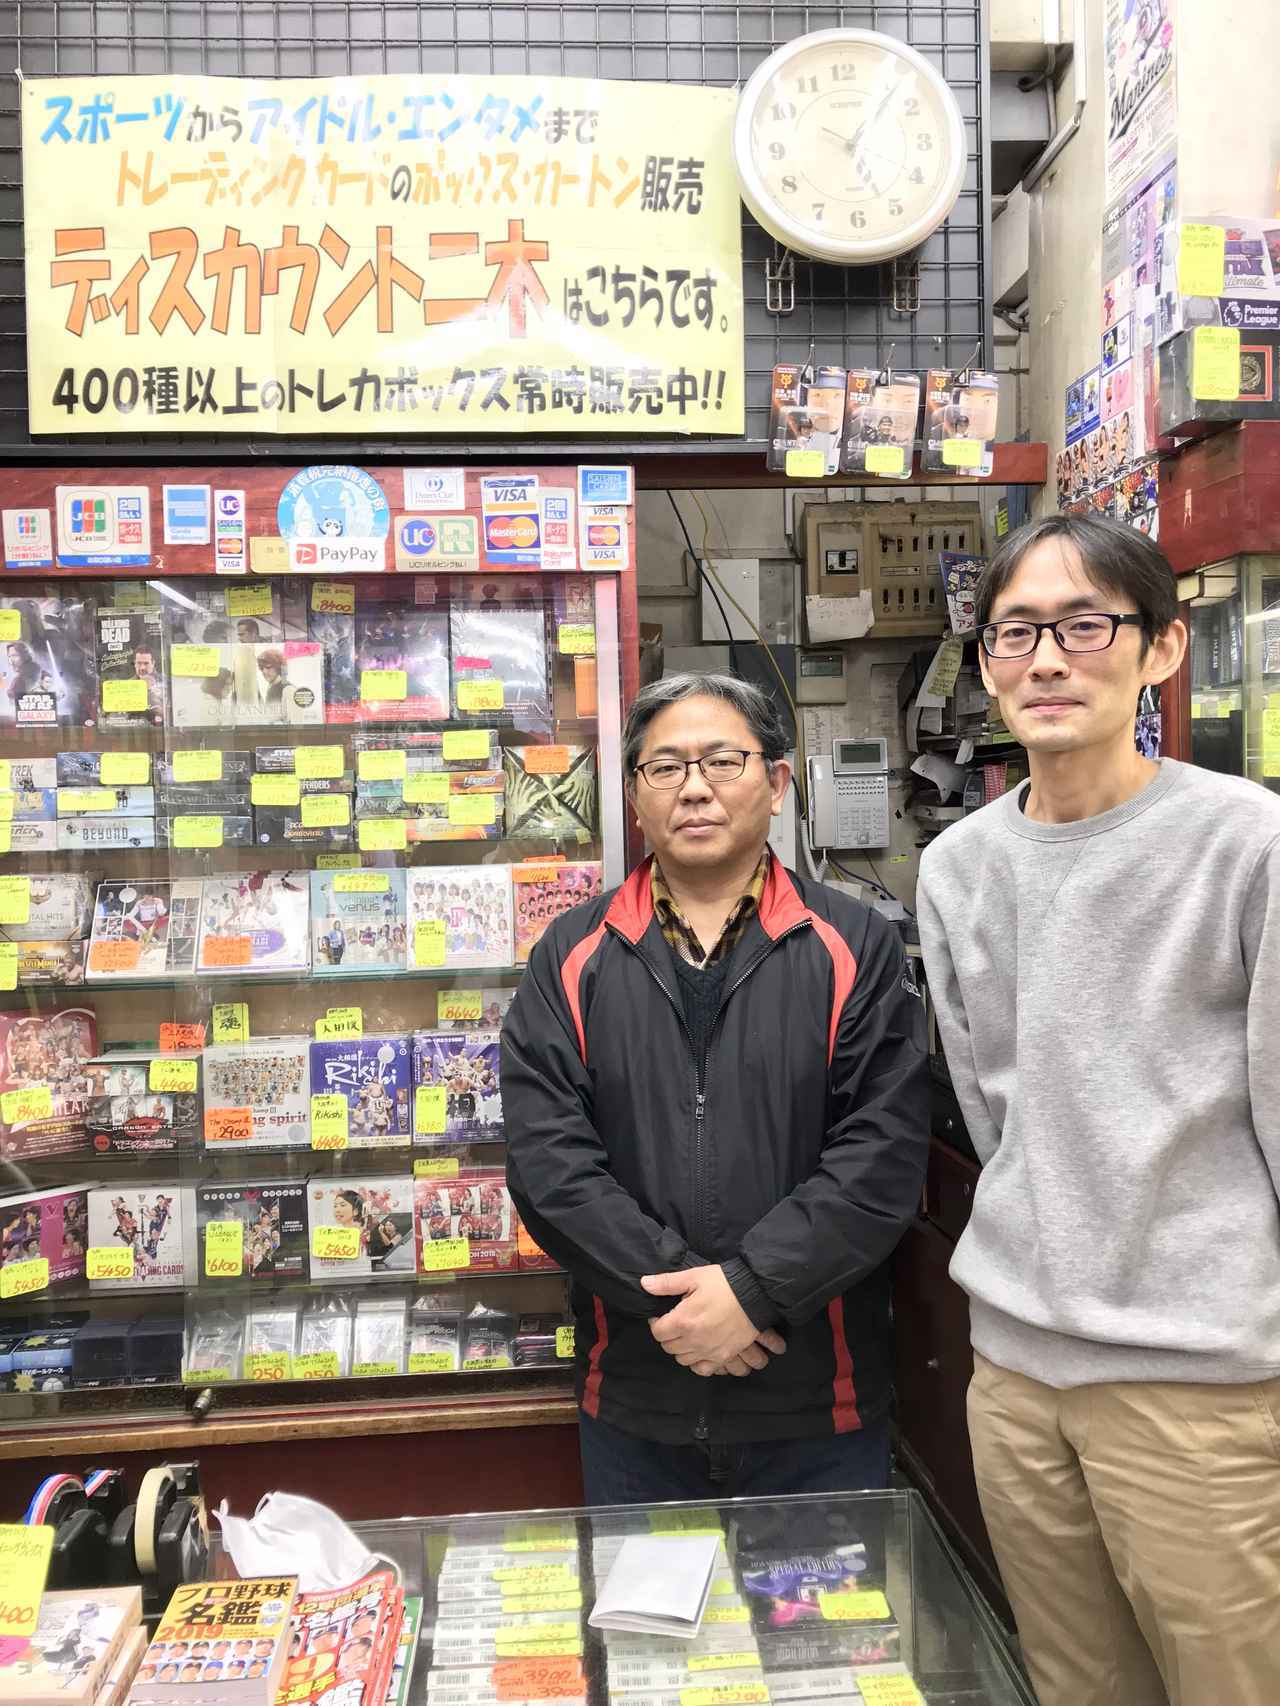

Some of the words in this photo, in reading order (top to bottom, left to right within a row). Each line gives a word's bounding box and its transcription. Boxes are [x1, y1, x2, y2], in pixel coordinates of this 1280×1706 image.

[830, 64, 856, 81] 12
[798, 77, 818, 93] 11
[771, 101, 796, 121] 10
[904, 99, 920, 116] 2
[917, 133, 932, 151] 3
[769, 142, 785, 160] 9
[909, 167, 925, 184] 4
[782, 176, 797, 193] 8
[812, 203, 825, 220] 7
[889, 199, 903, 216] 5
[850, 210, 866, 228] 6
[1244, 304, 1279, 315] Premier
[1244, 315, 1278, 326] League
[494, 488, 528, 502] VISA
[72, 512, 105, 521] JCB
[593, 507, 614, 515] VISA
[402, 527, 434, 548] UC
[489, 526, 538, 537] MasterCard
[320, 546, 379, 562] PayPay
[593, 550, 616, 559] VISA
[339, 903, 381, 912] venus
[269, 1111, 307, 1126] spirit
[178, 1582, 291, 1603] プロ野球
[175, 1600, 262, 1626] 名鑑
[158, 1624, 224, 1641] 2019
